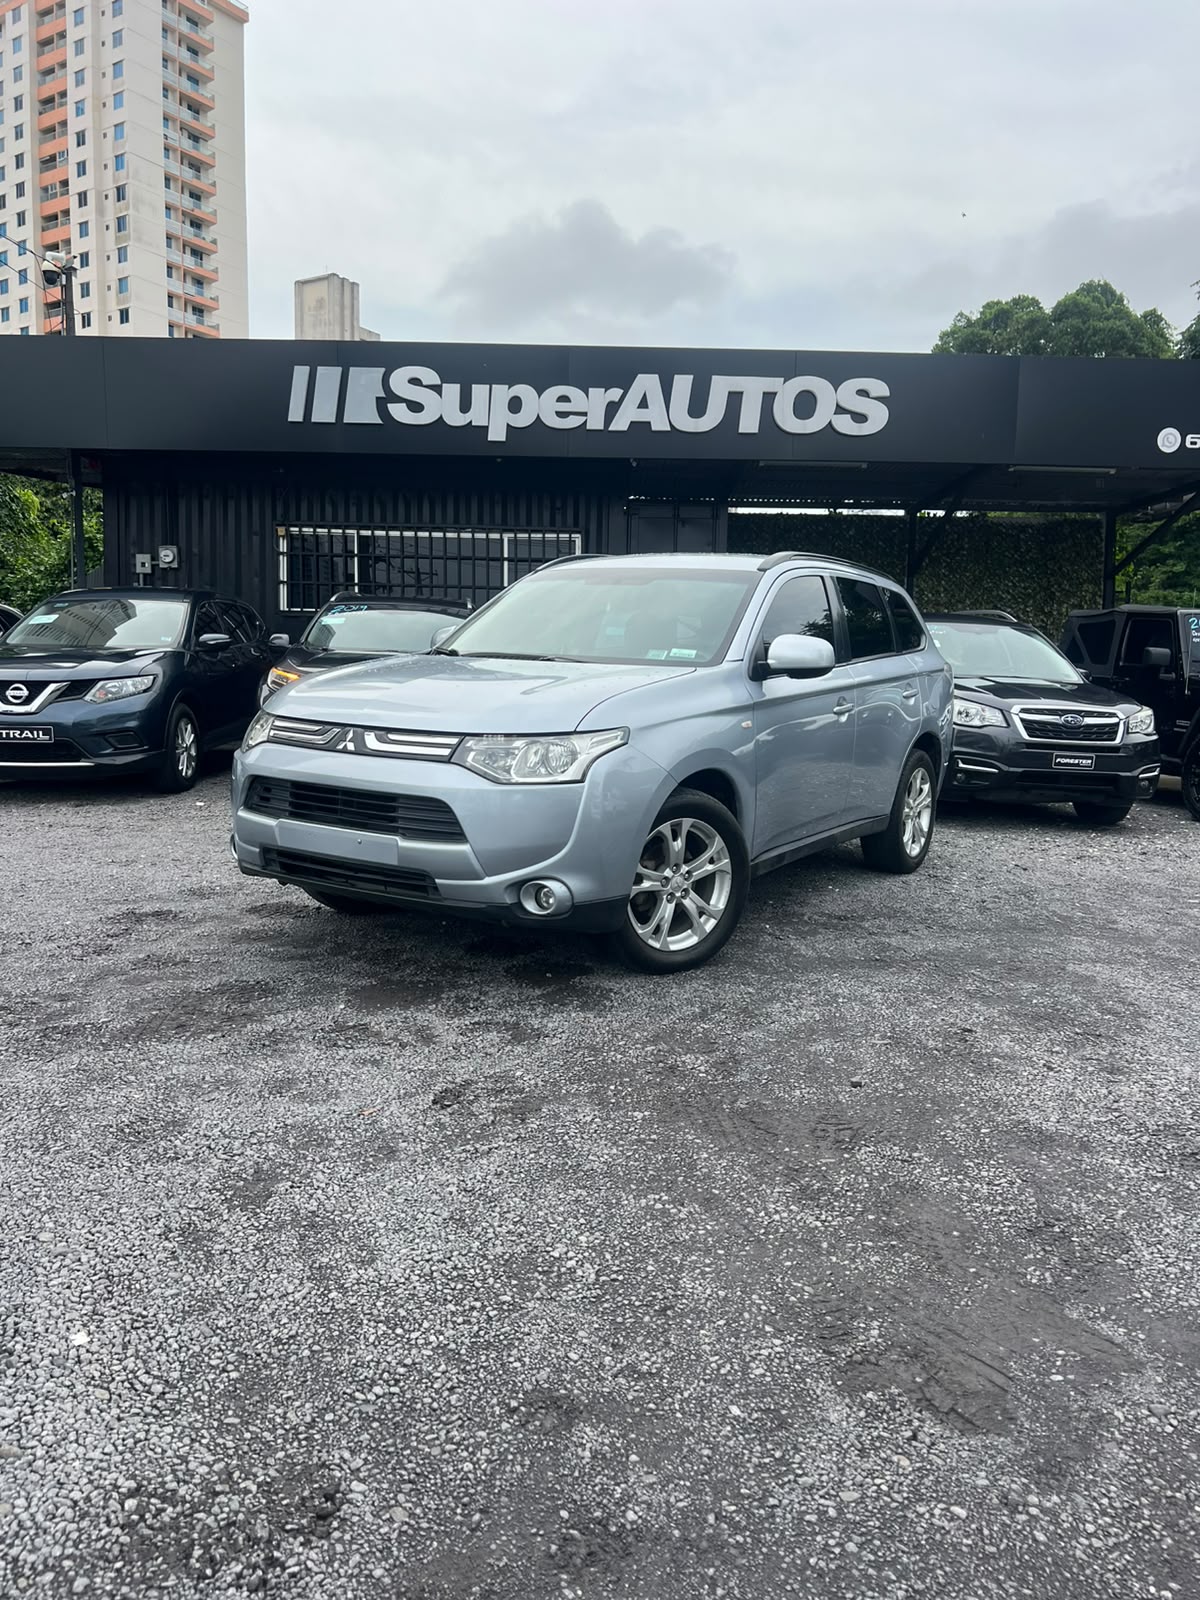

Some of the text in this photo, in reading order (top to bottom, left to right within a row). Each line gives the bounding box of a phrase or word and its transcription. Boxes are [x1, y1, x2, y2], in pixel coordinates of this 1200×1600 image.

[386, 365, 891, 442] SuperAUTOS
[1185, 433, 1200, 449] 6
[1188, 617, 1200, 629] 2
